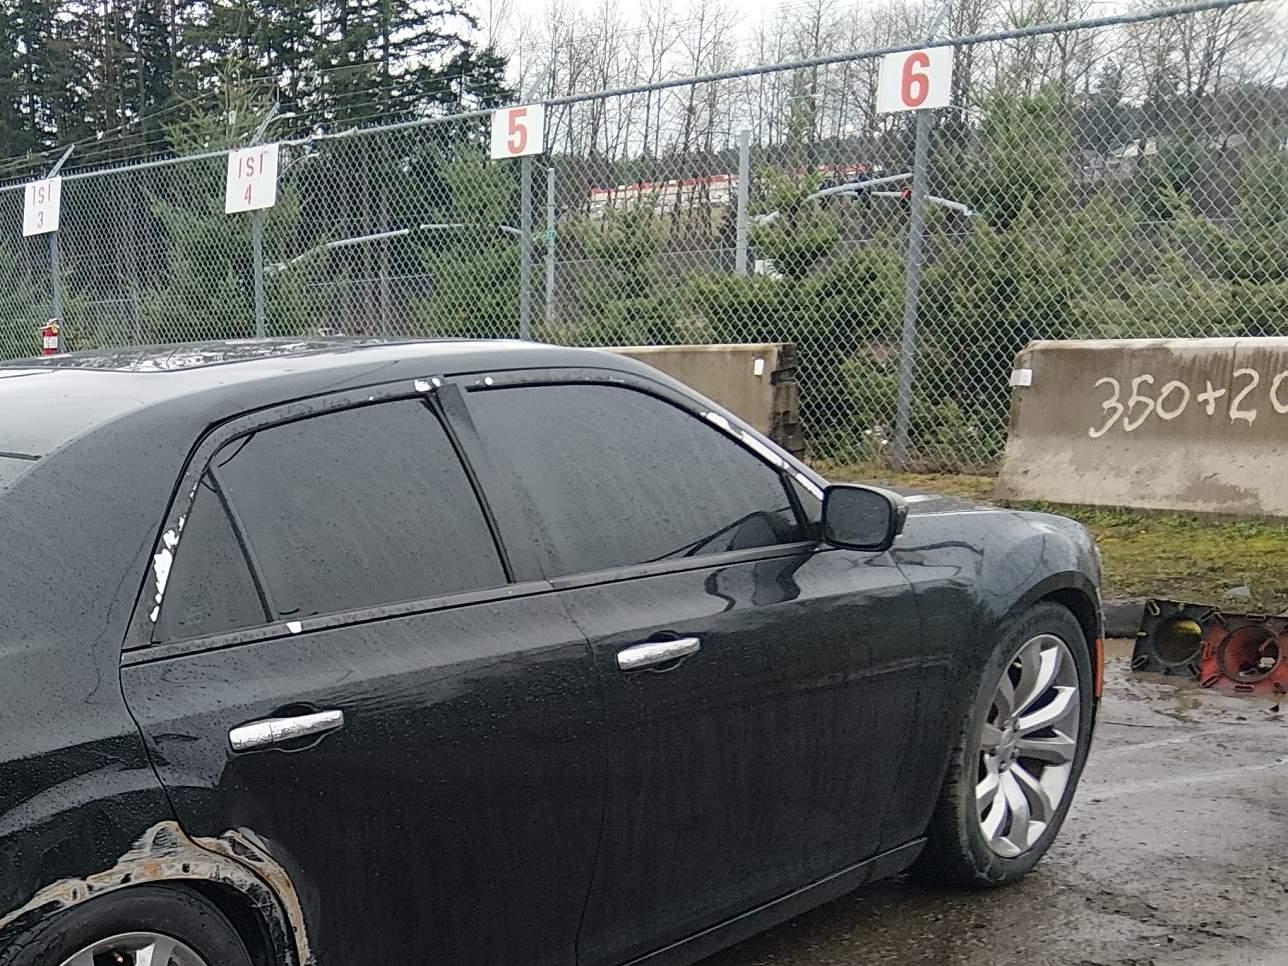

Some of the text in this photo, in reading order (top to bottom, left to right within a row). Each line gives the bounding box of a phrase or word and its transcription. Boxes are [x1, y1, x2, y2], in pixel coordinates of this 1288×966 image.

[901, 52, 930, 107] 6
[507, 108, 527, 154] 5
[244, 183, 252, 205] 4
[37, 211, 44, 229] 3
